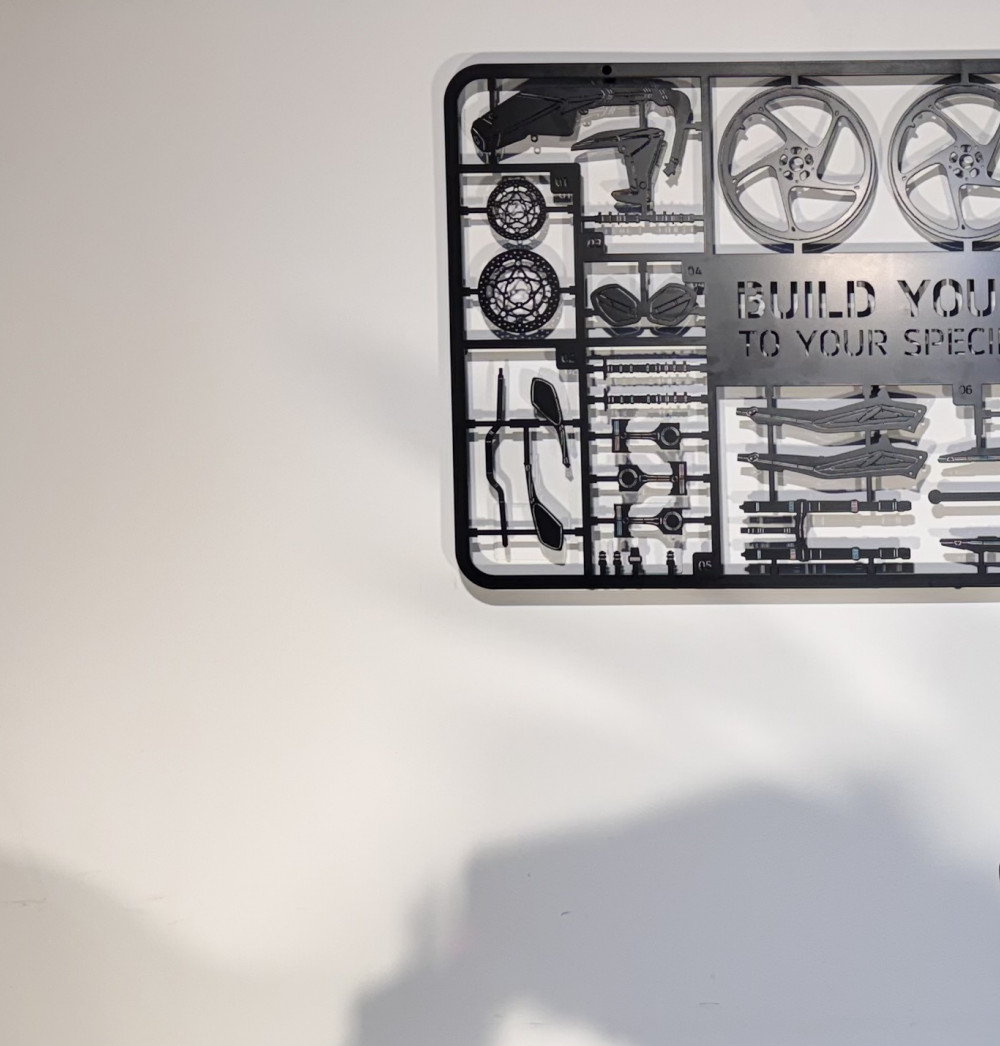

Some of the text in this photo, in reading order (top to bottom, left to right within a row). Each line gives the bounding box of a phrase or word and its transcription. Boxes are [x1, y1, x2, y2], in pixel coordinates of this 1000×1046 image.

[687, 265, 702, 276] 04
[737, 280, 876, 319] BUILD
[738, 329, 780, 357] TO
[796, 328, 888, 357] YOUR
[958, 384, 973, 395] 06
[698, 559, 712, 571] 05
